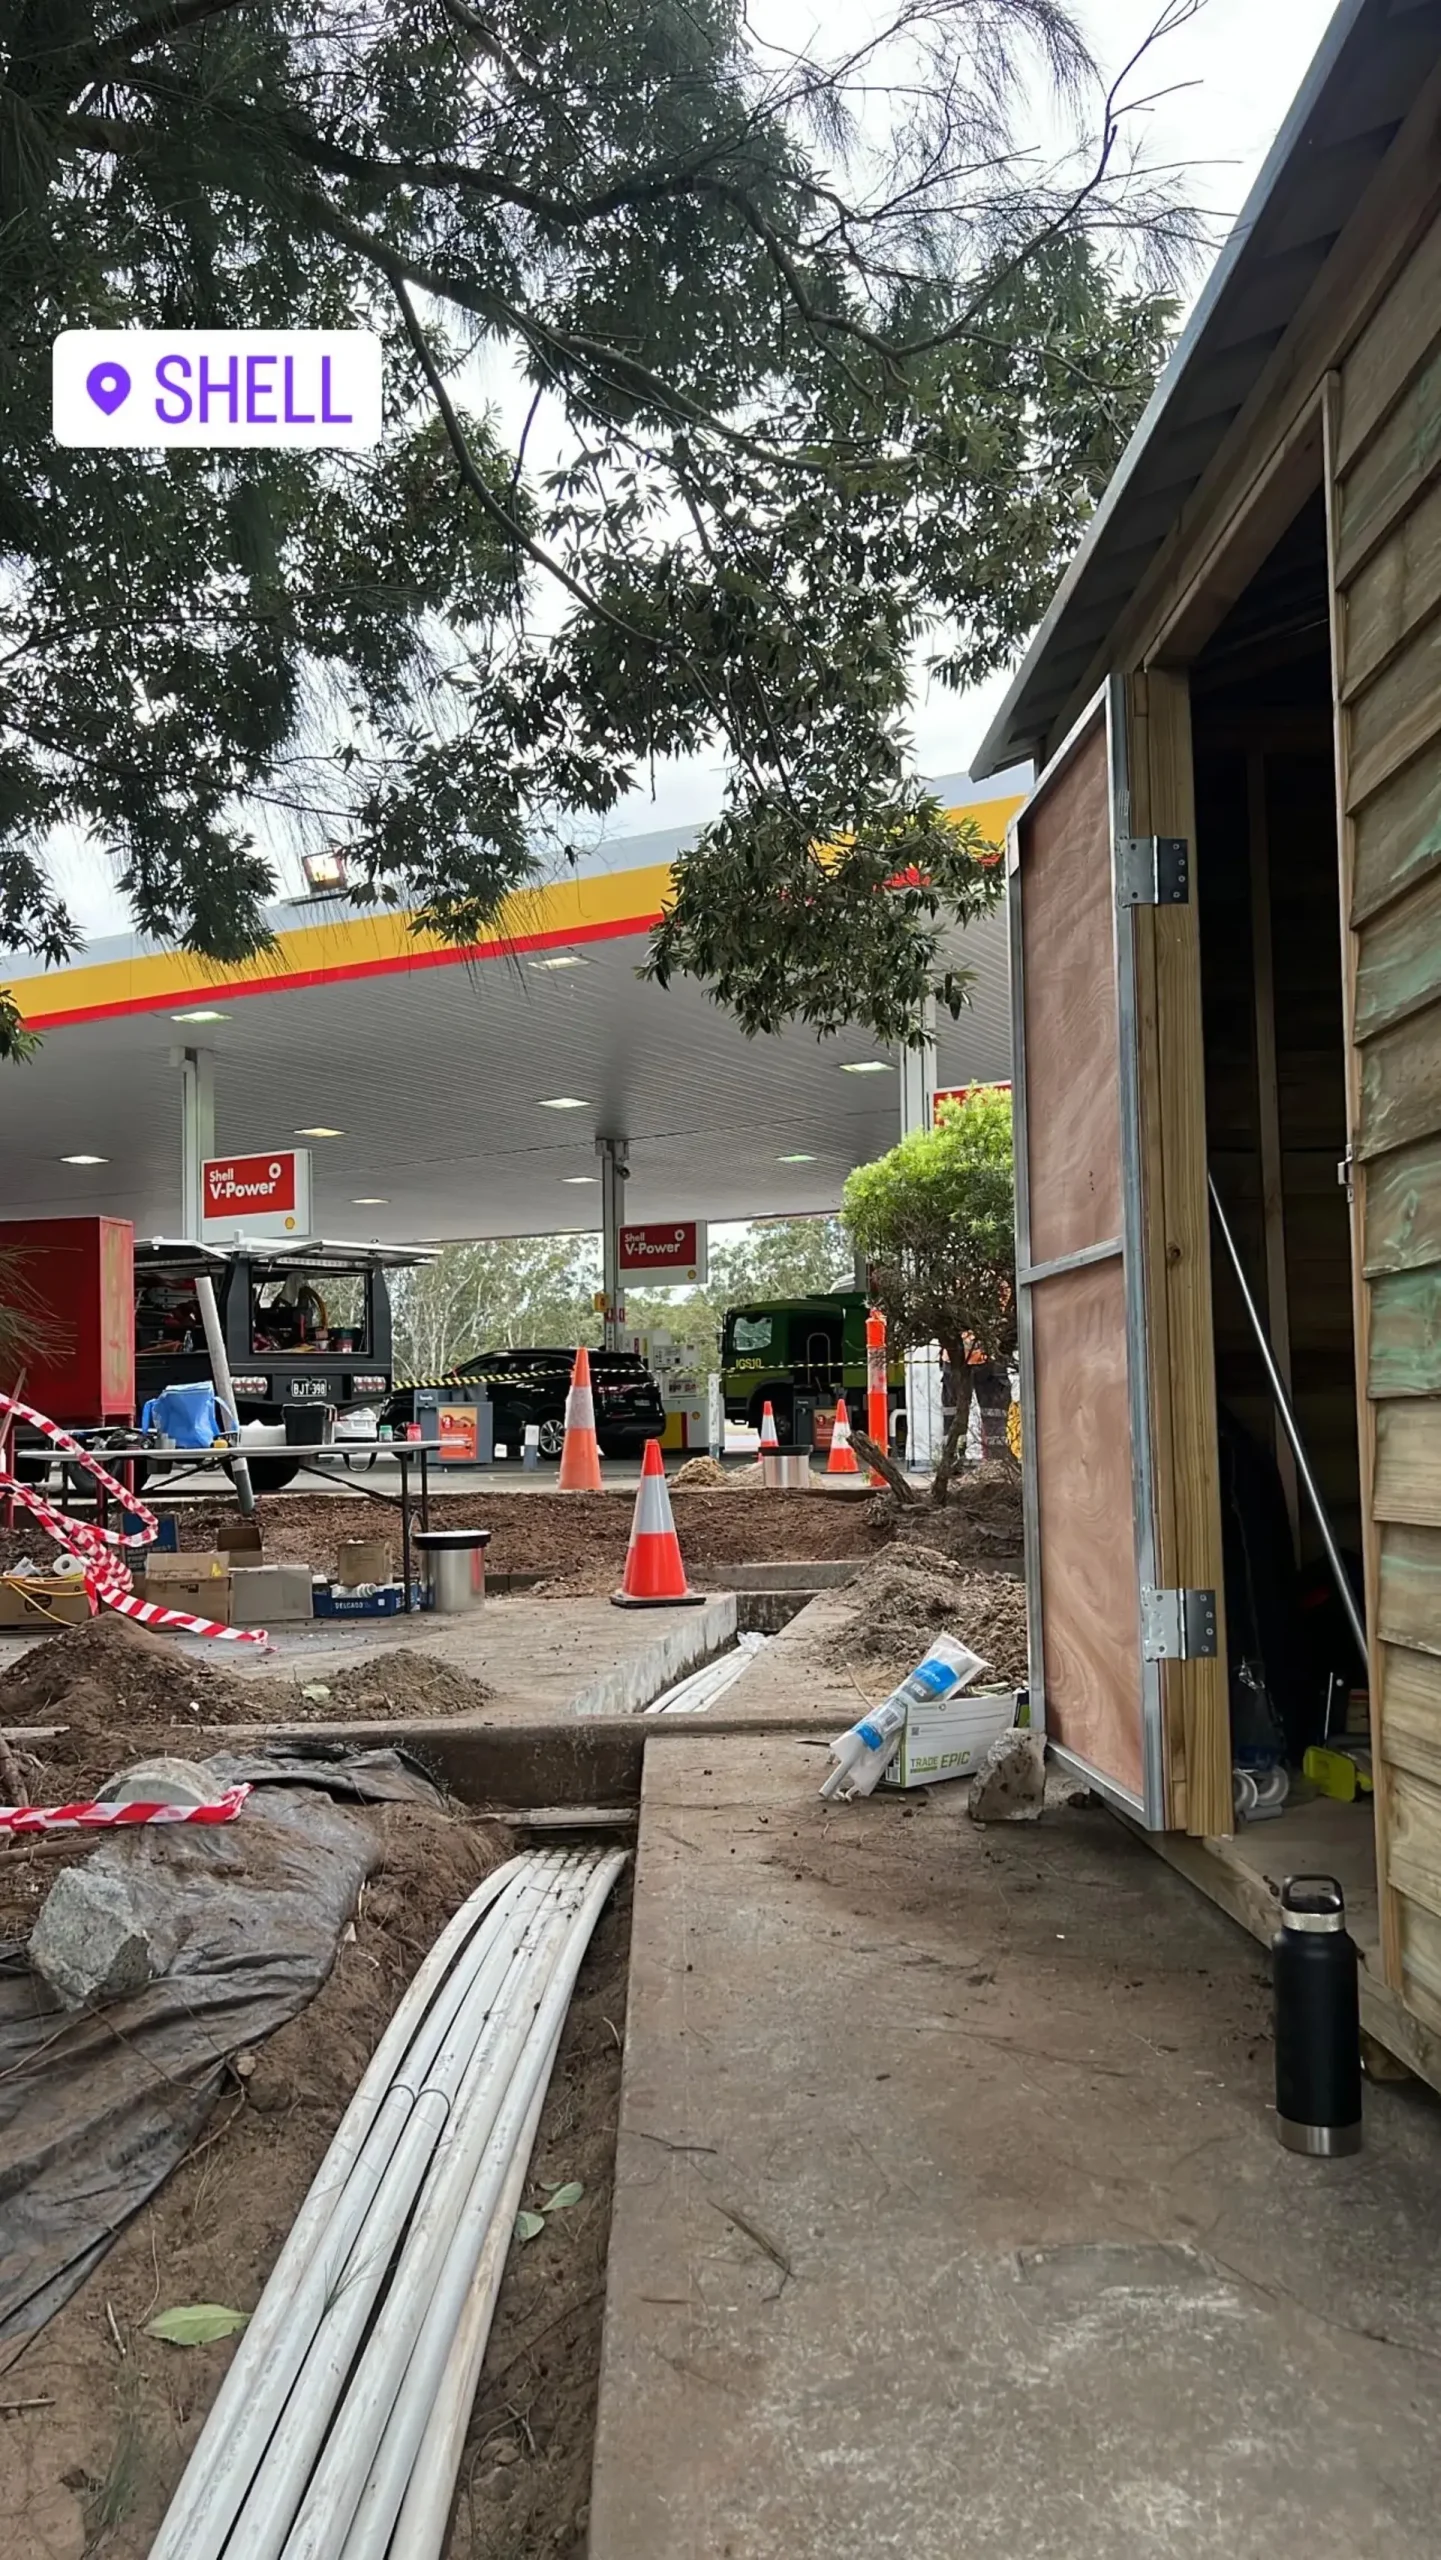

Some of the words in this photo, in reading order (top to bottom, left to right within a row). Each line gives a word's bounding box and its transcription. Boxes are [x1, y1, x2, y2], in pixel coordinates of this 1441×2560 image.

[209, 1168, 234, 1182] Shell
[210, 1181, 276, 1200] V-Power
[624, 1232, 645, 1242] Shell
[625, 1243, 680, 1256] V-Power
[910, 1756, 939, 1767] TRADE
[941, 1751, 970, 1768] EPIC
